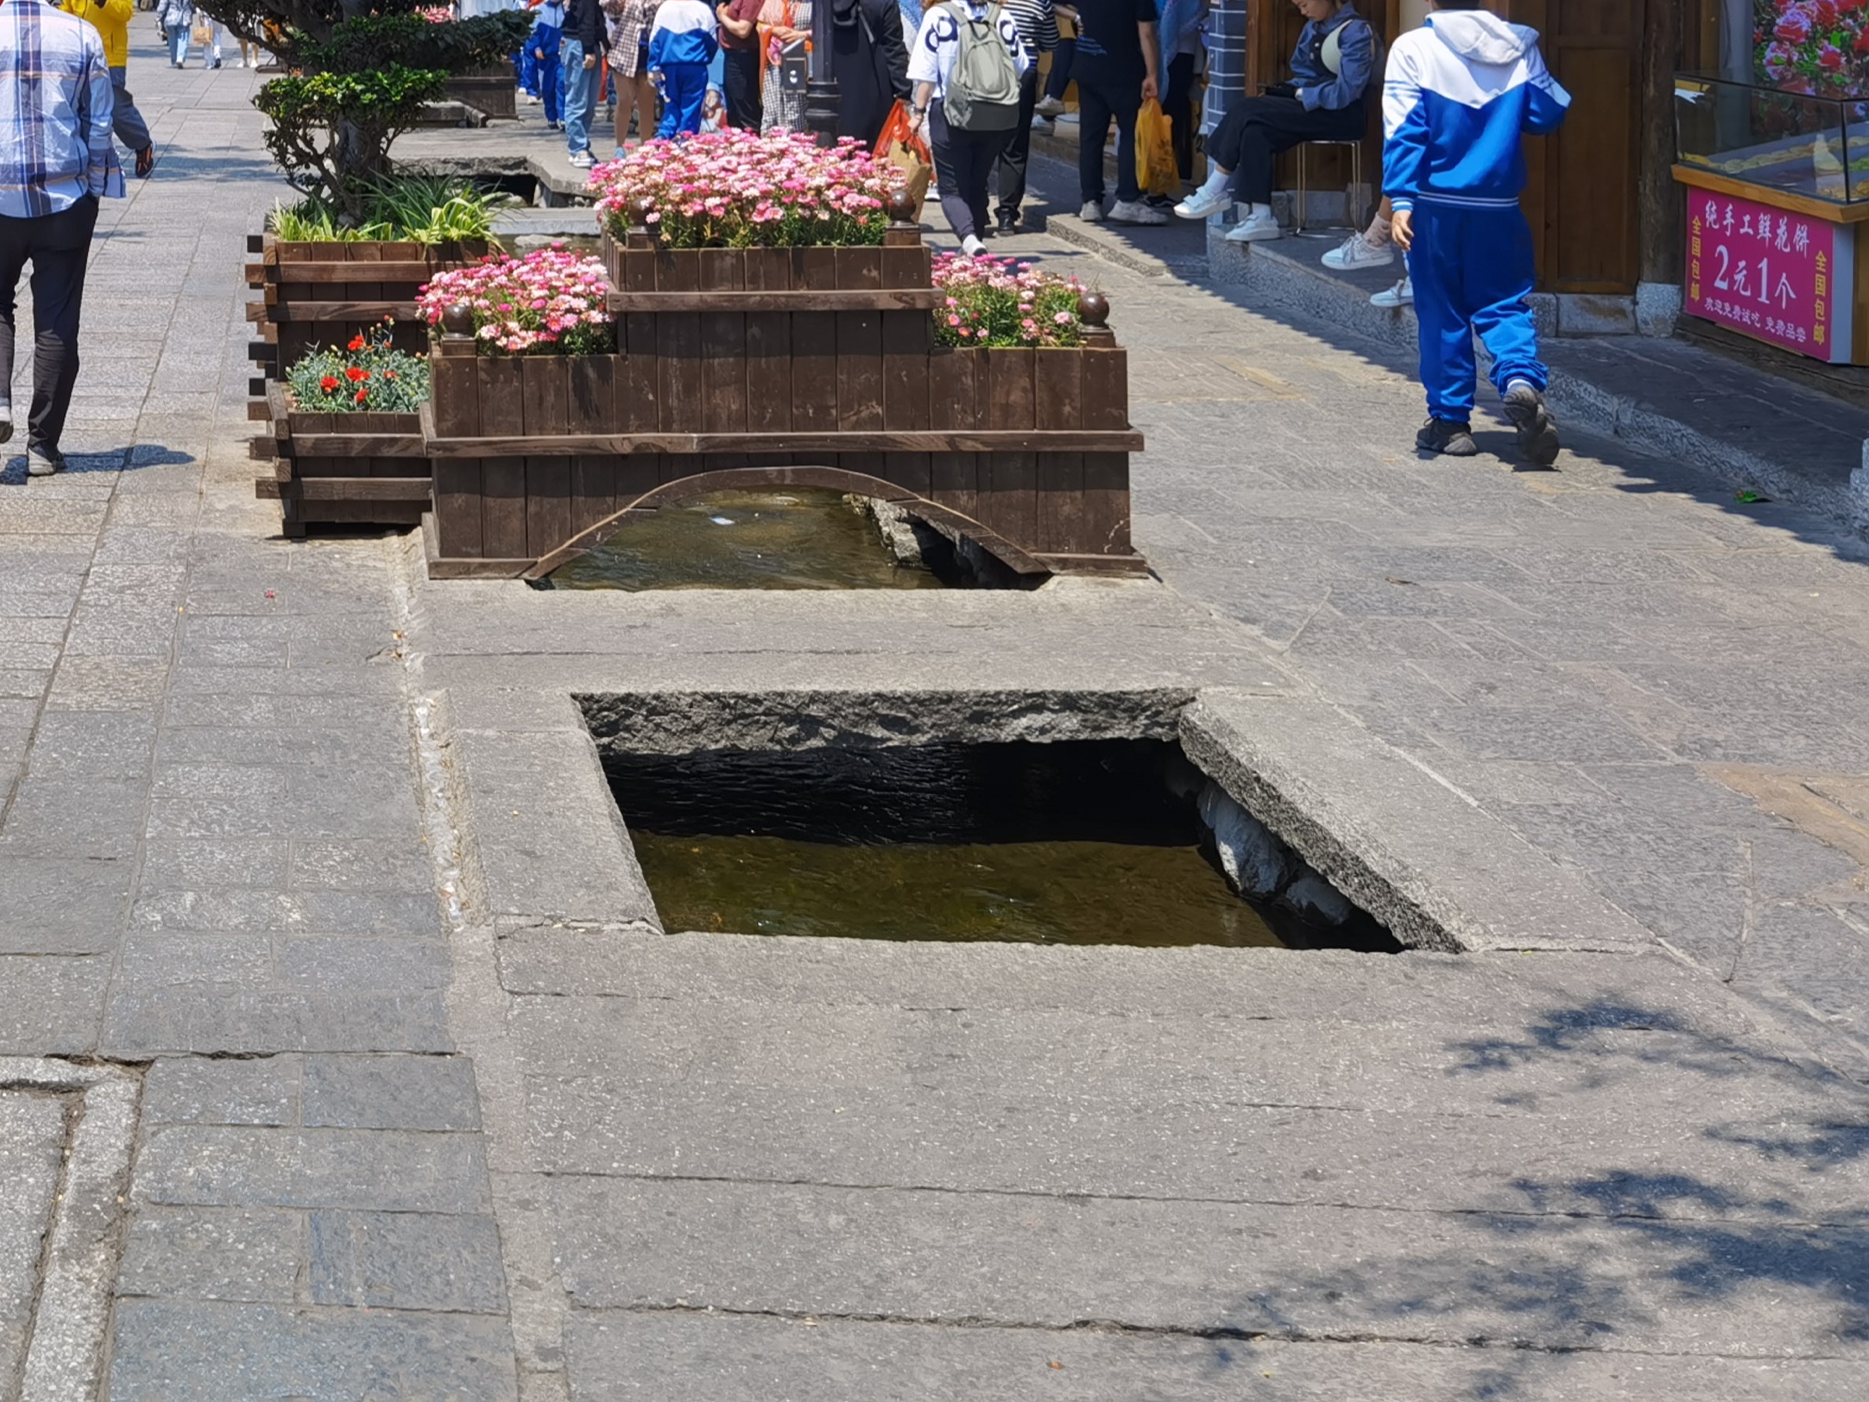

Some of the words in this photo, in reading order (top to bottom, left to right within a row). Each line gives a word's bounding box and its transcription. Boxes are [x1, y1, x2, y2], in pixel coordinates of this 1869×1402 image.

[1705, 199, 1810, 259] 纯手工鲜花饼
[1813, 250, 1828, 345] 全国包邮
